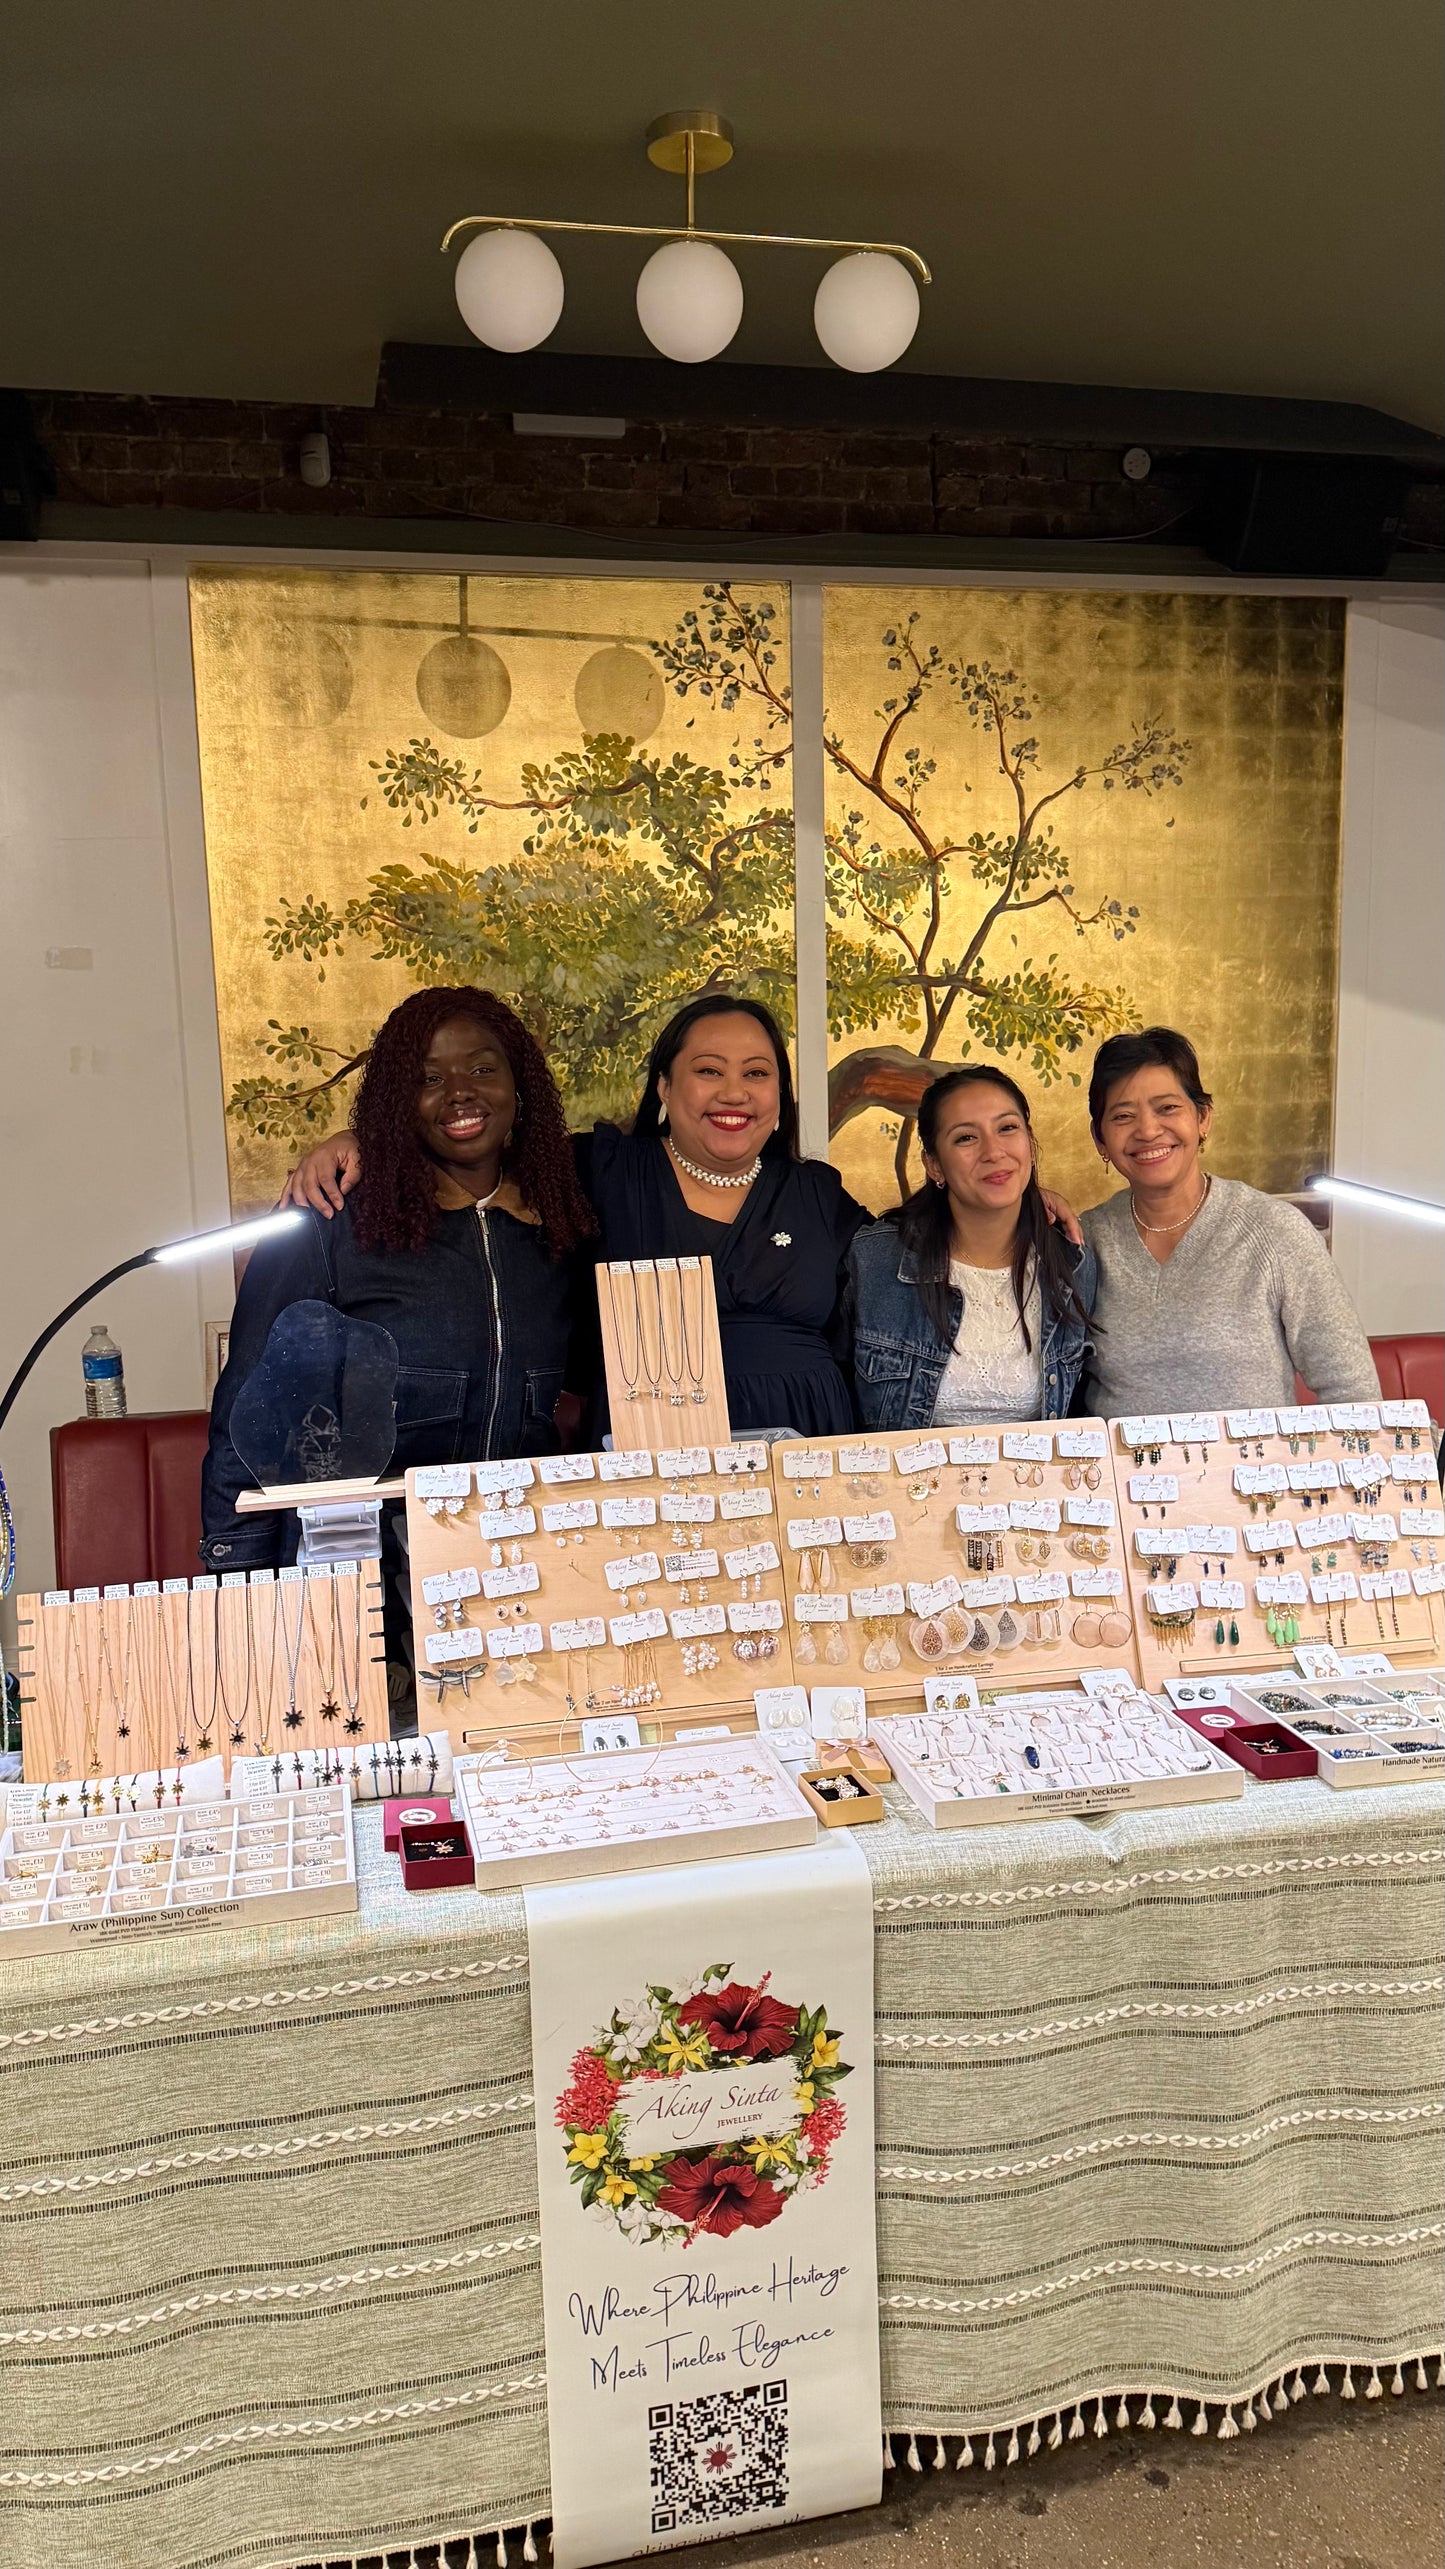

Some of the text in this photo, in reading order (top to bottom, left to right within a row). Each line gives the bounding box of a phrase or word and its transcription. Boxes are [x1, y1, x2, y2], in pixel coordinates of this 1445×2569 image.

[1382, 1757, 1420, 1767] Handmade
[1032, 1786, 1130, 1802] Minimal Chain Necklaces
[70, 1903, 240, 1932] Araw (Philippine Sun) Collection
[636, 2084, 784, 2140] Aking Sinta
[717, 2112, 763, 2128] JEWELLERY
[568, 2256, 850, 2335] Where Philippine Heritage
[590, 2320, 835, 2392] Meets Timeless Elegance
